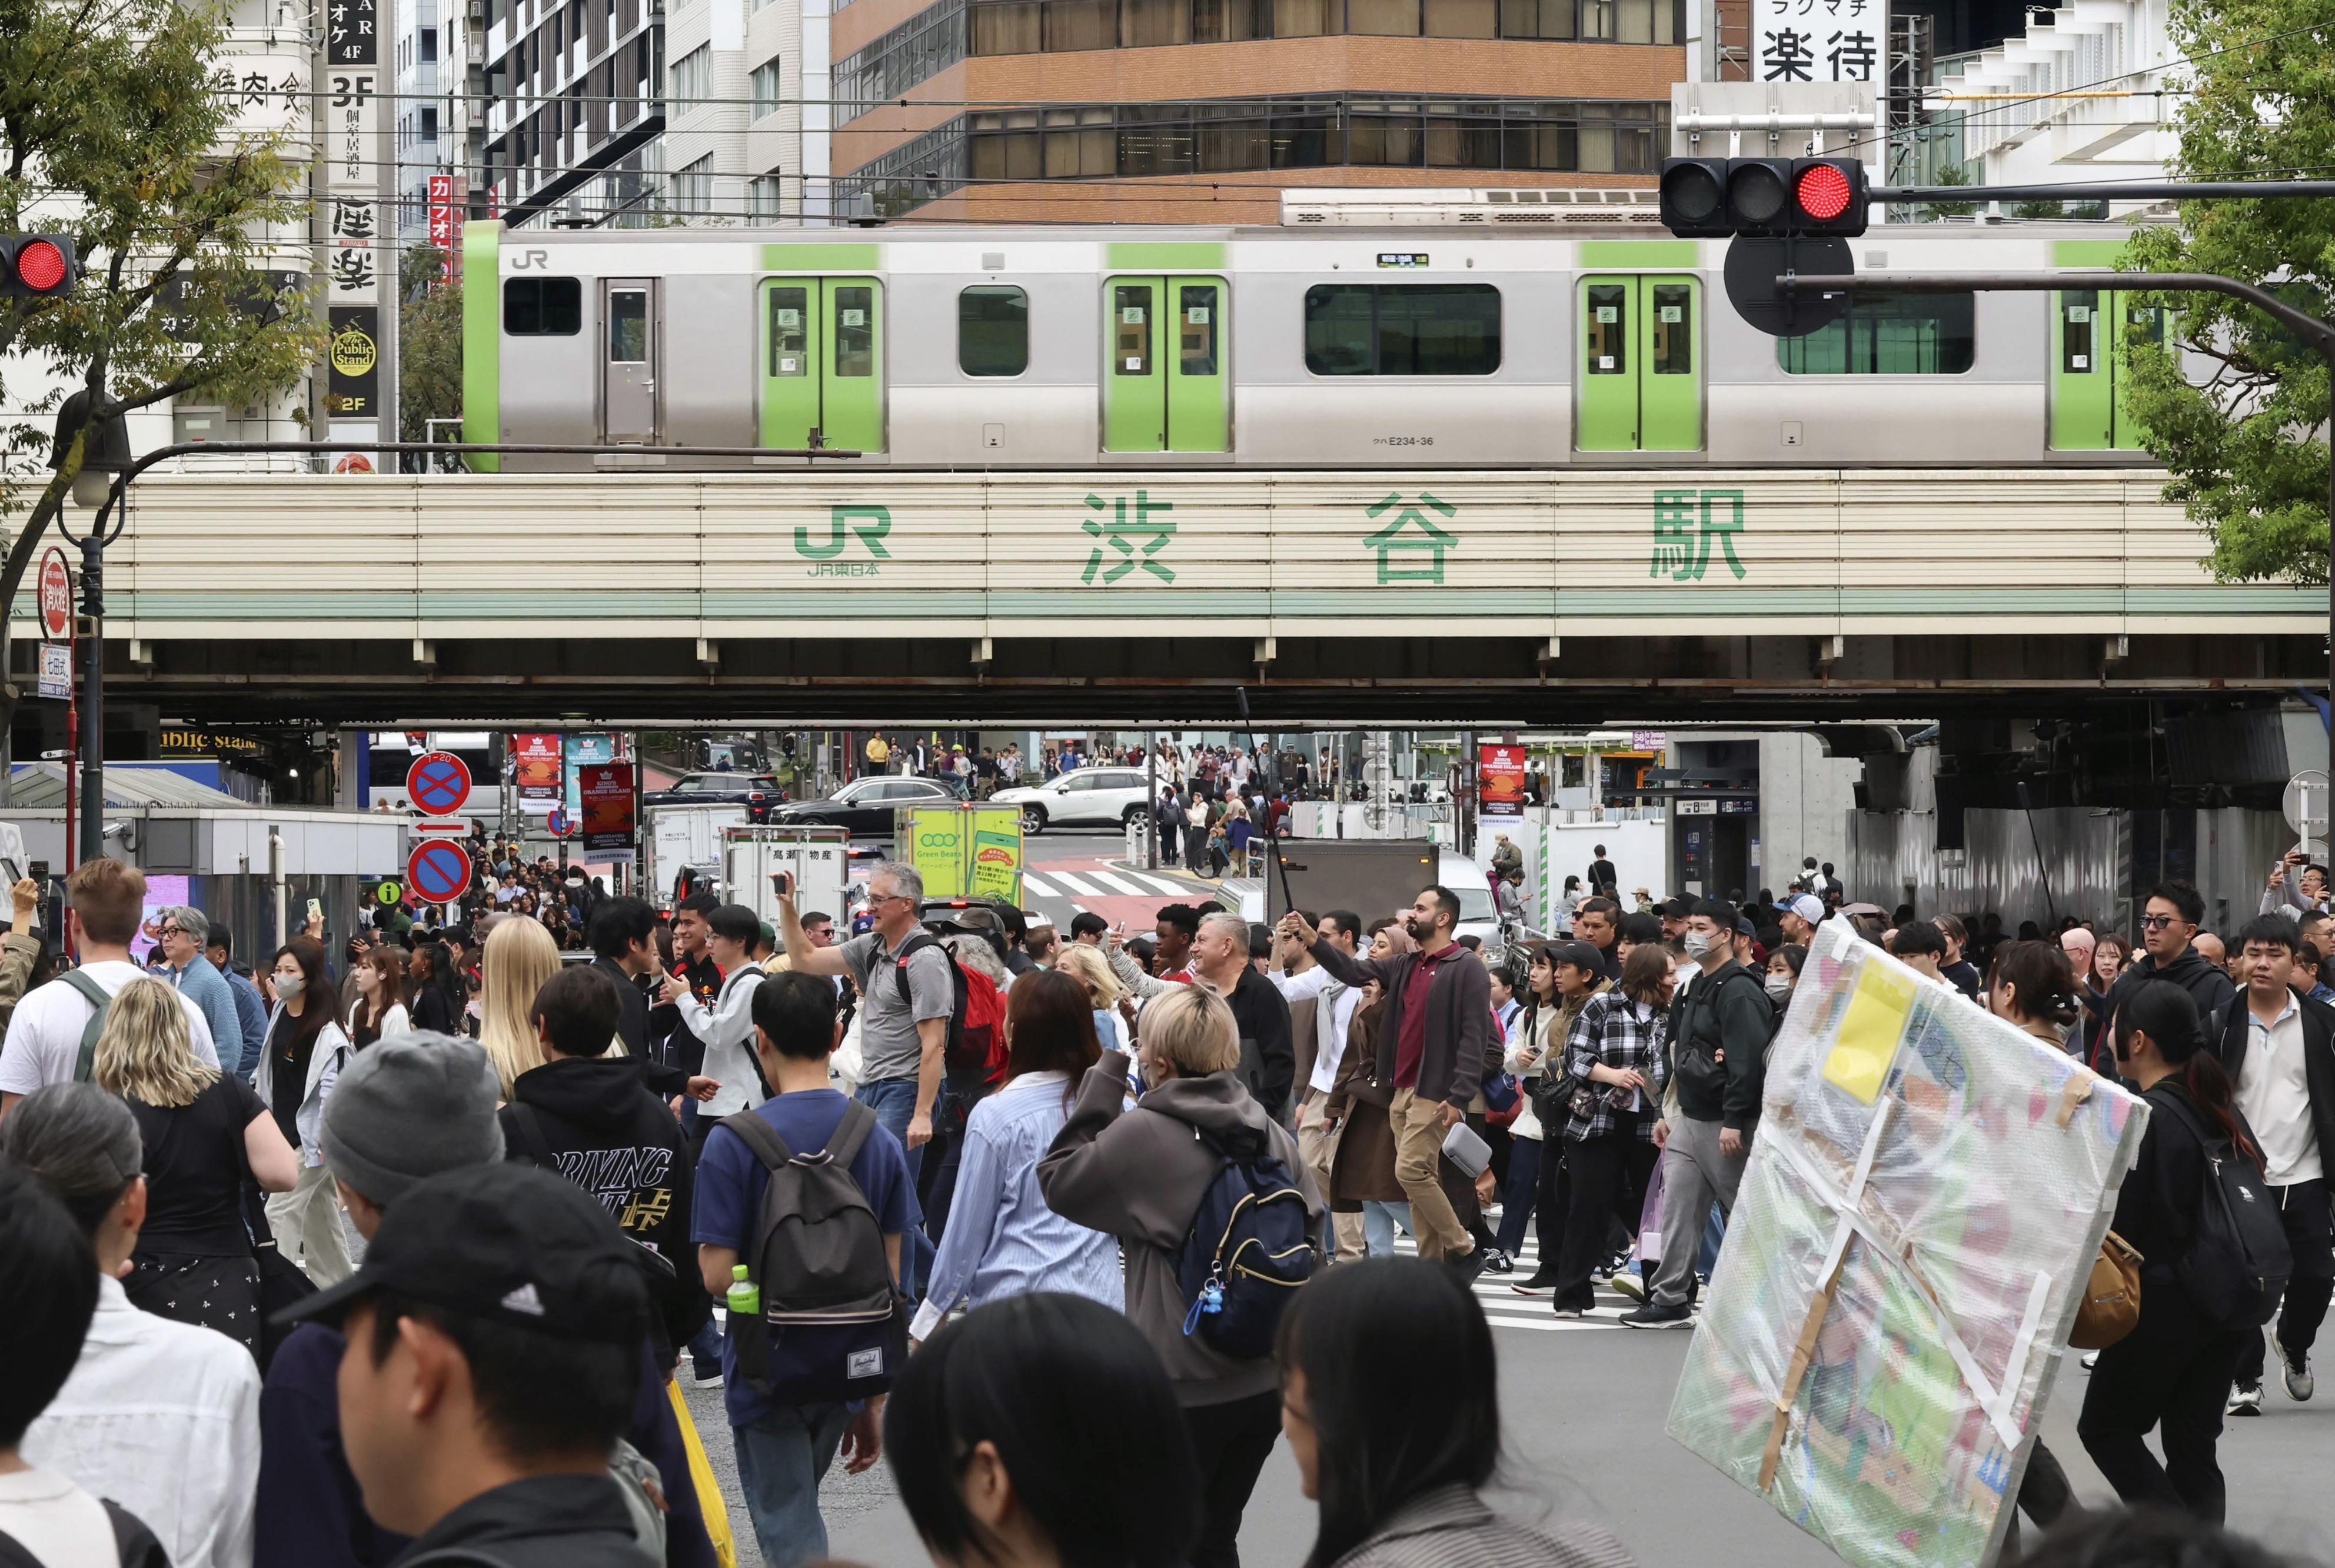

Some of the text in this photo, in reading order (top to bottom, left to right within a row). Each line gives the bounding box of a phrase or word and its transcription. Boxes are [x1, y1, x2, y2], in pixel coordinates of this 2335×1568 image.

[330, 0, 349, 44] オケ
[342, 45, 362, 58] 4F
[1762, 27, 1877, 82] 楽待
[332, 76, 373, 108] 3F
[346, 109, 360, 179] 個室居酒屋
[511, 249, 548, 269] JR
[337, 343, 372, 354] Public
[337, 354, 370, 365] Stand
[342, 397, 365, 411] 2F
[794, 504, 893, 559] JR
[807, 562, 880, 577] JR東日本
[46, 583, 66, 612] 消火栓
[1635, 734, 1644, 742] 58
[809, 850, 832, 860] 物産
[551, 1146, 673, 1192] RIVING
[620, 1187, 673, 1231] 峠
